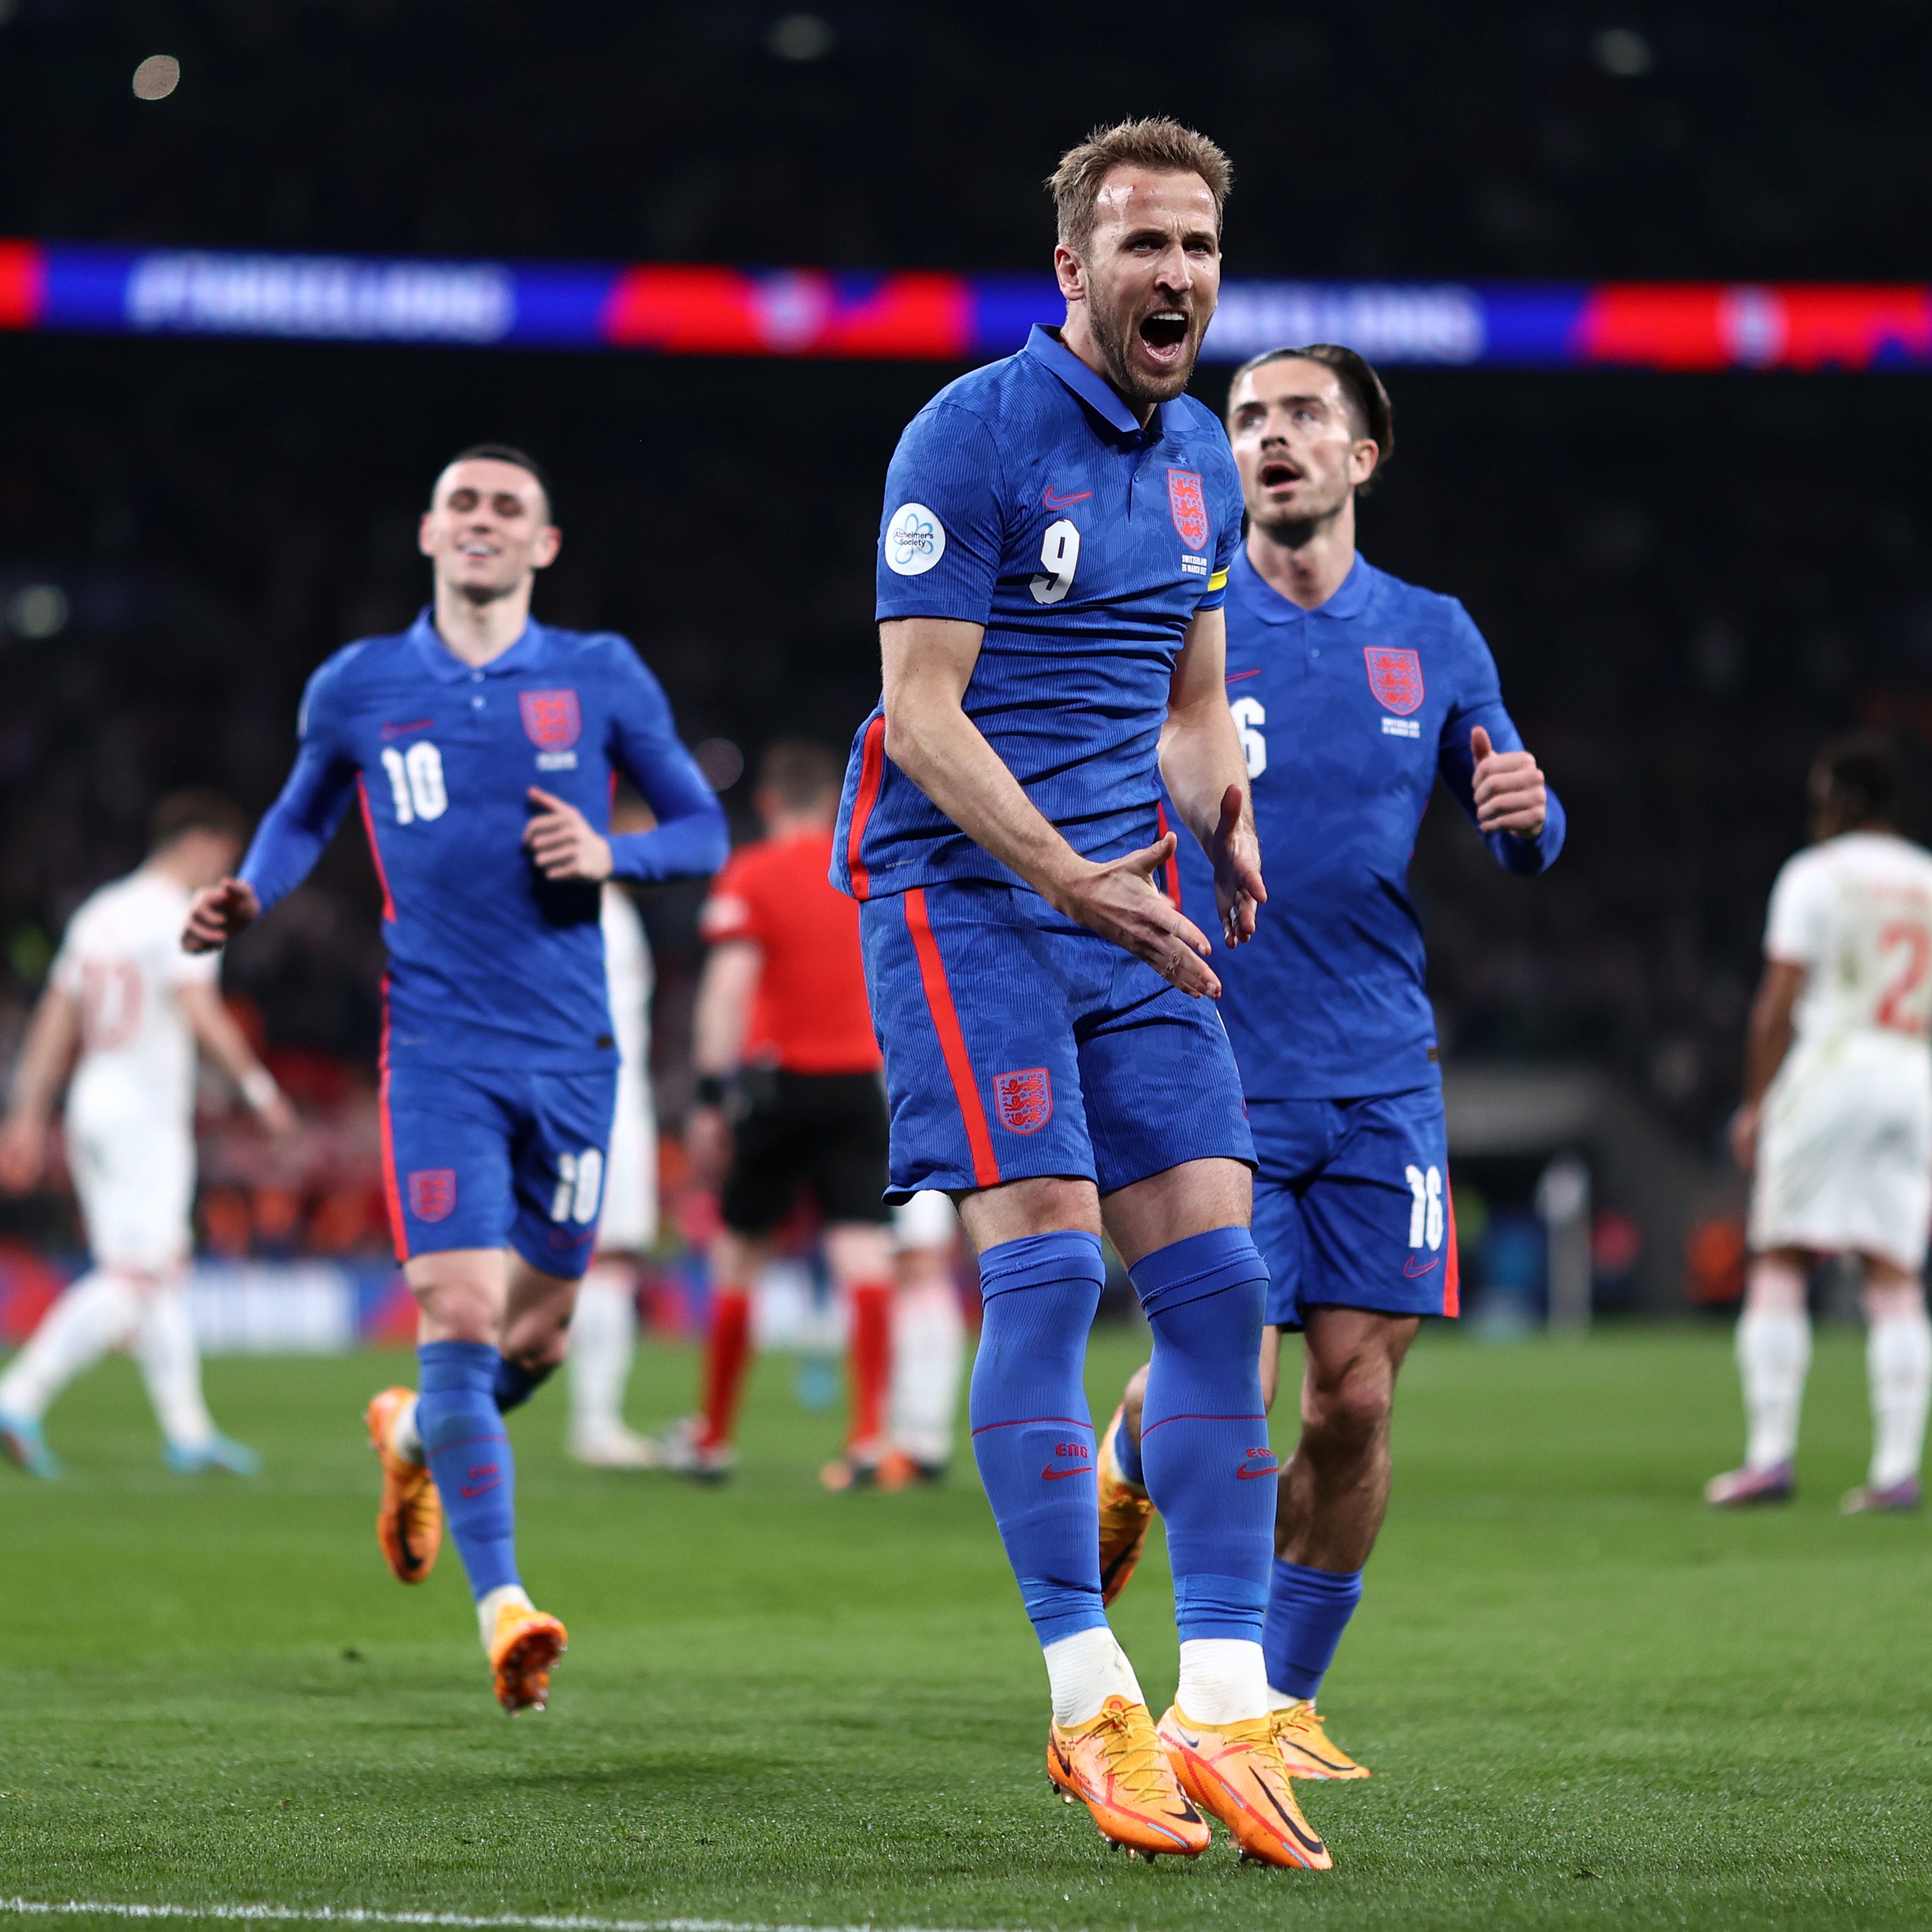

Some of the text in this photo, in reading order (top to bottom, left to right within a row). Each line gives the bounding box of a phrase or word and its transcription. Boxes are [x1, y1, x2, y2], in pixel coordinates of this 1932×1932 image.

[895, 531, 934, 539] Alzheimer's
[900, 539, 926, 548] Society
[1029, 519, 1080, 605] 9
[381, 740, 448, 825] 10
[551, 1147, 603, 1224] 10
[1405, 1164, 1444, 1251] 16
[1055, 1443, 1088, 1458] ENG
